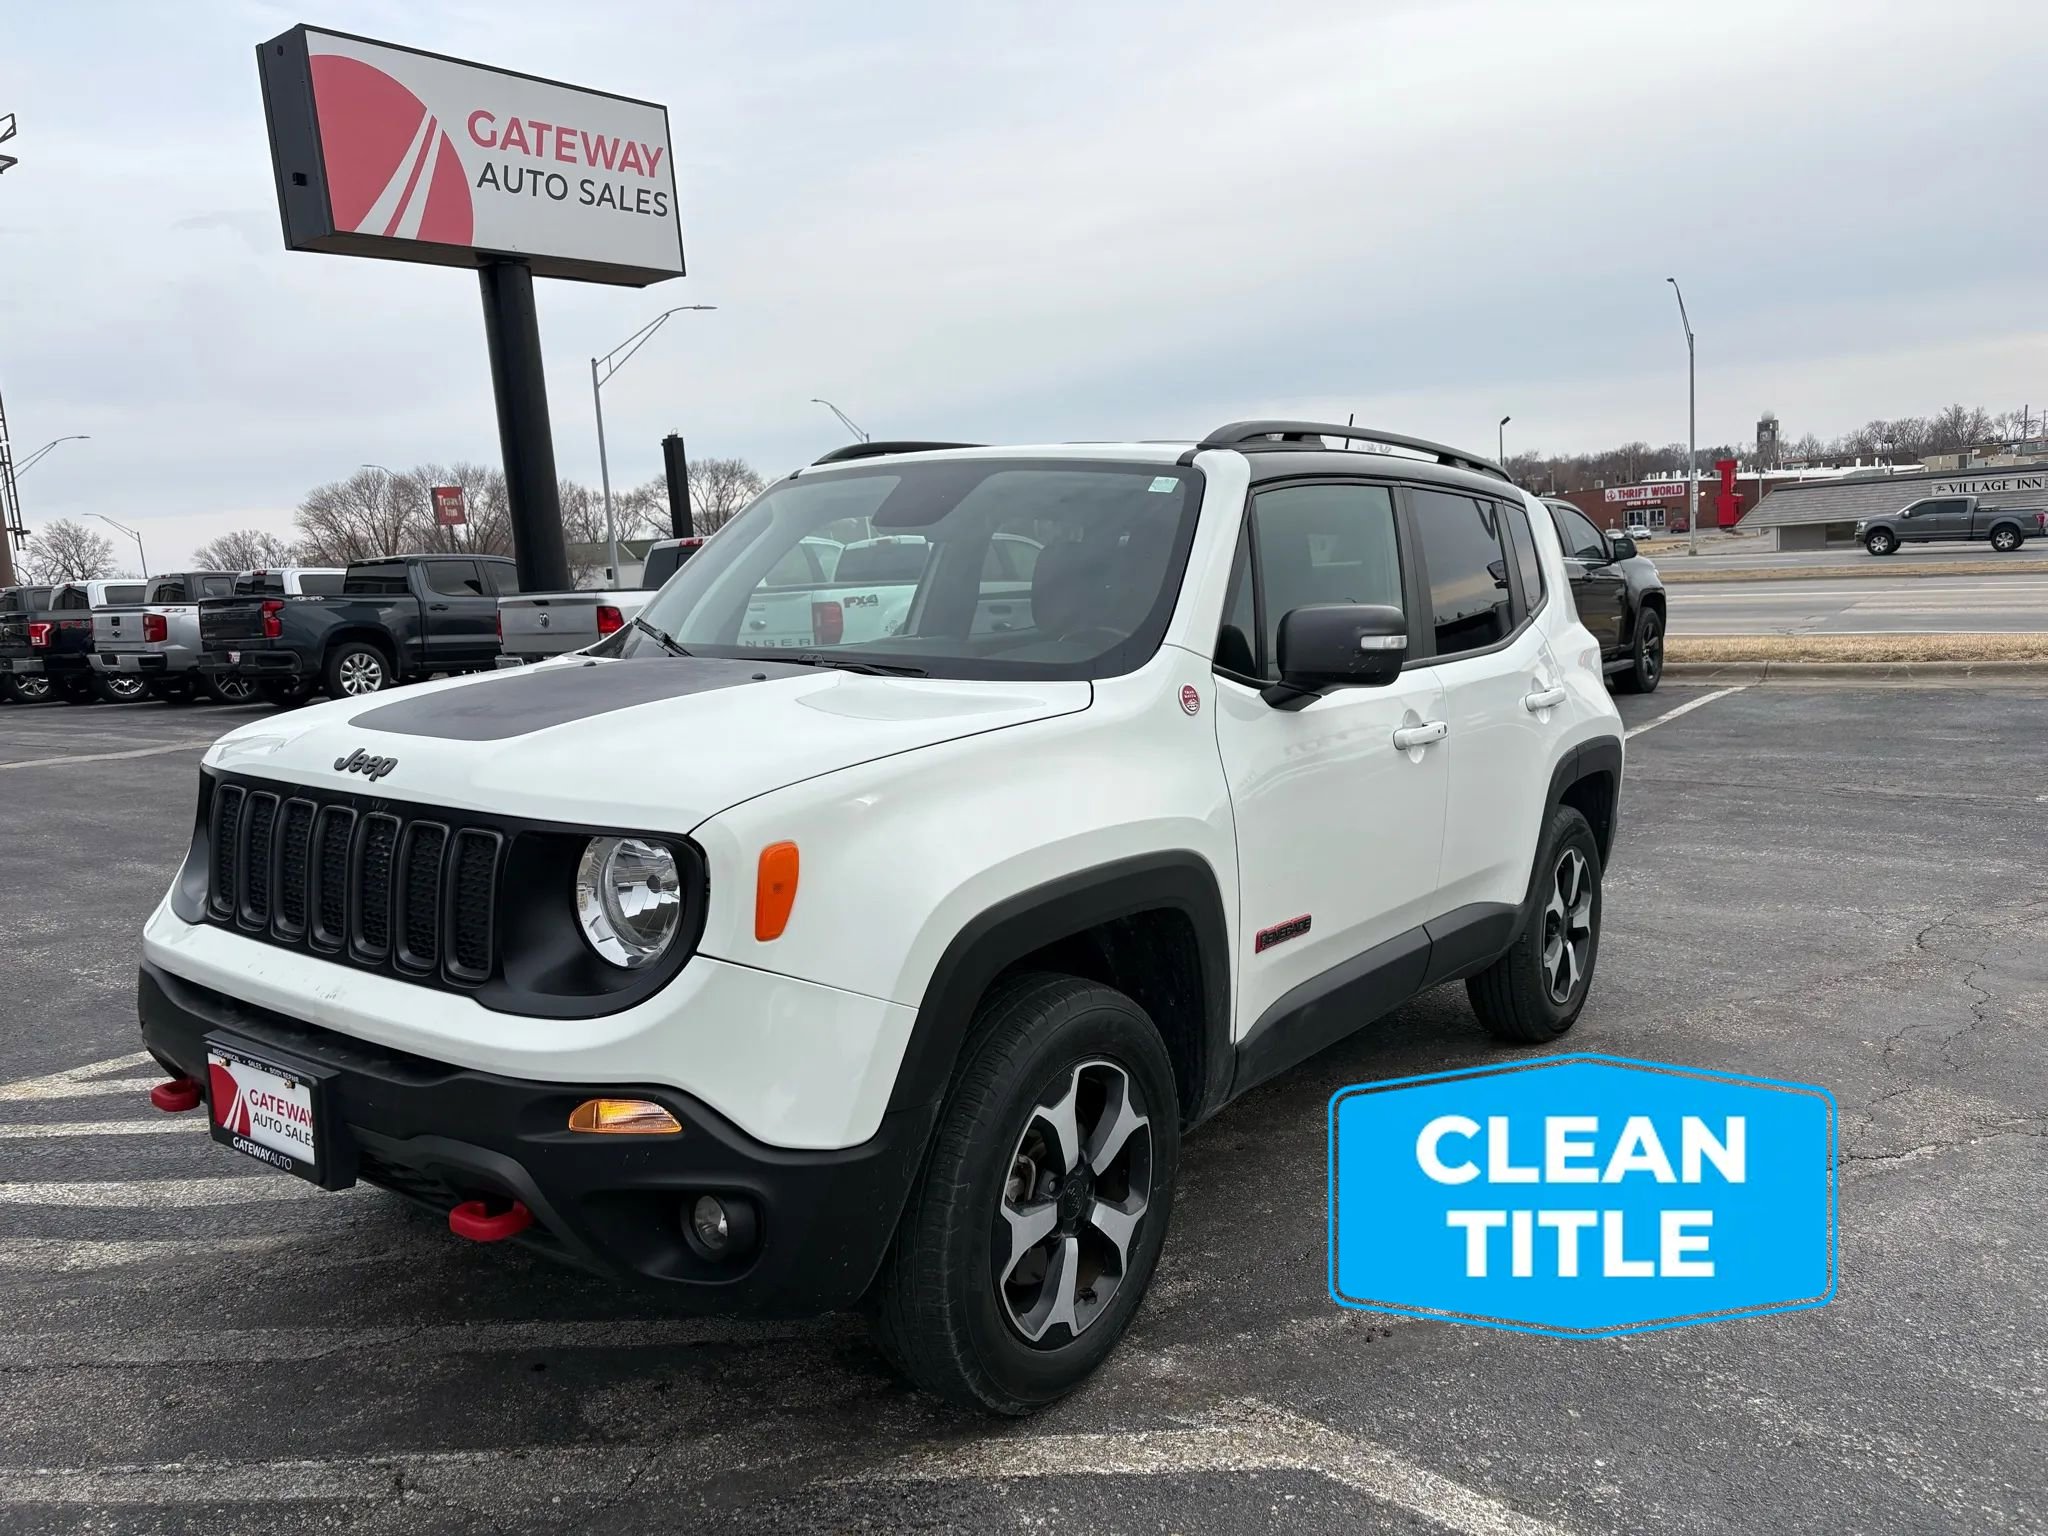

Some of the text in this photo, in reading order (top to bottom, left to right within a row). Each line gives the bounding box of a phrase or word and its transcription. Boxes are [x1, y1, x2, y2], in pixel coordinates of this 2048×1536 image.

[467, 109, 664, 178] GATEWAY
[476, 162, 669, 217] AUTO SALES
[1618, 485, 1683, 499] THRIFT WORLD
[1949, 480, 2009, 493] VILLAGE
[2017, 478, 2042, 489] INN
[843, 594, 879, 608] FX4
[745, 638, 811, 648] NGER
[334, 747, 398, 782] Jeep
[249, 1089, 313, 1128] GATEWAY
[252, 1112, 283, 1134] AUTO
